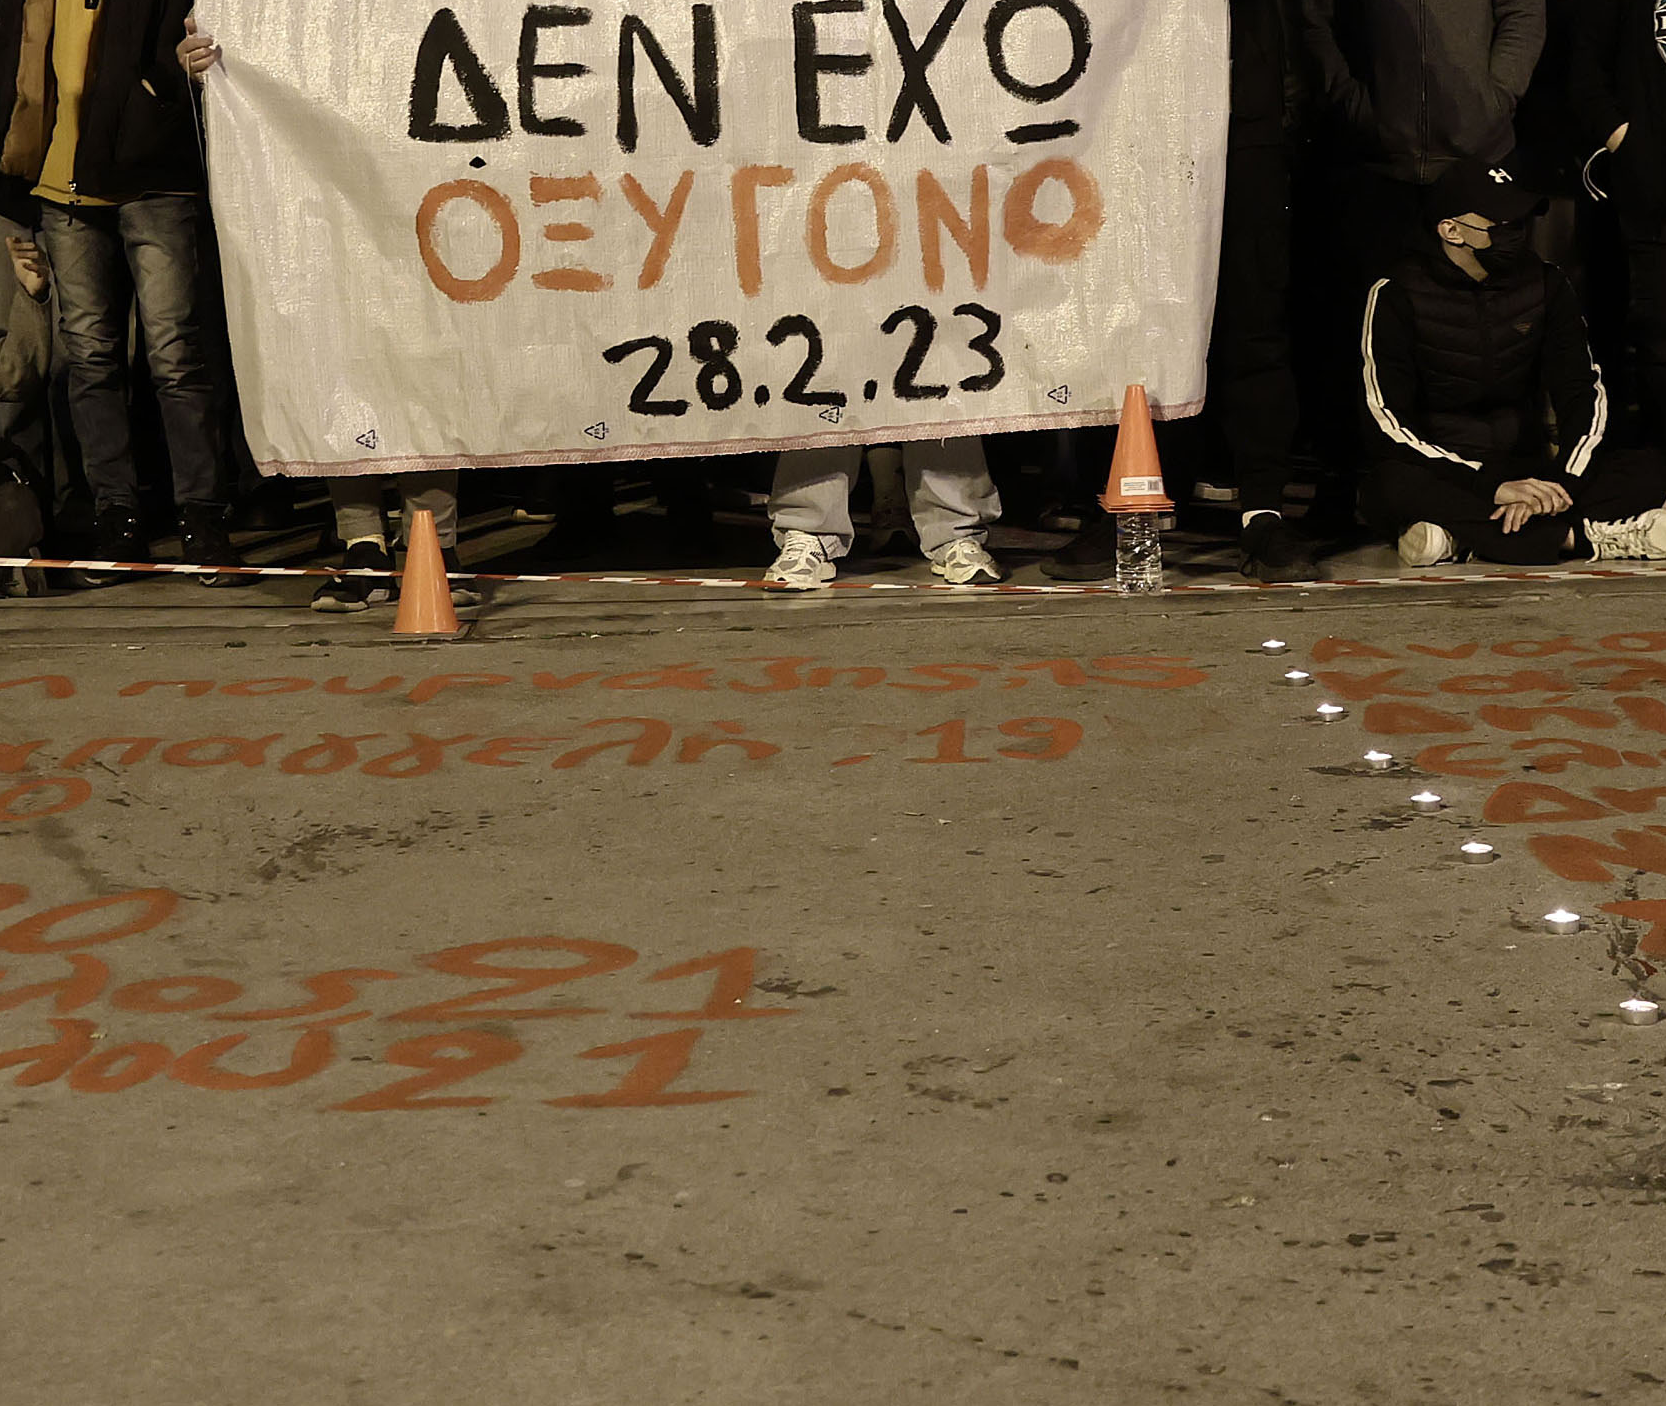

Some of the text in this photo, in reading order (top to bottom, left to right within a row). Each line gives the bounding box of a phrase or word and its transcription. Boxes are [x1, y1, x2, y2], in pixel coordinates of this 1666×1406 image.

[407, 4, 722, 153] ΔΕΝ
[415, 155, 1107, 303] ΟΞΥΓΟΝΟ
[602, 302, 1007, 417] 28.2.23
[920, 717, 1083, 763] 19
